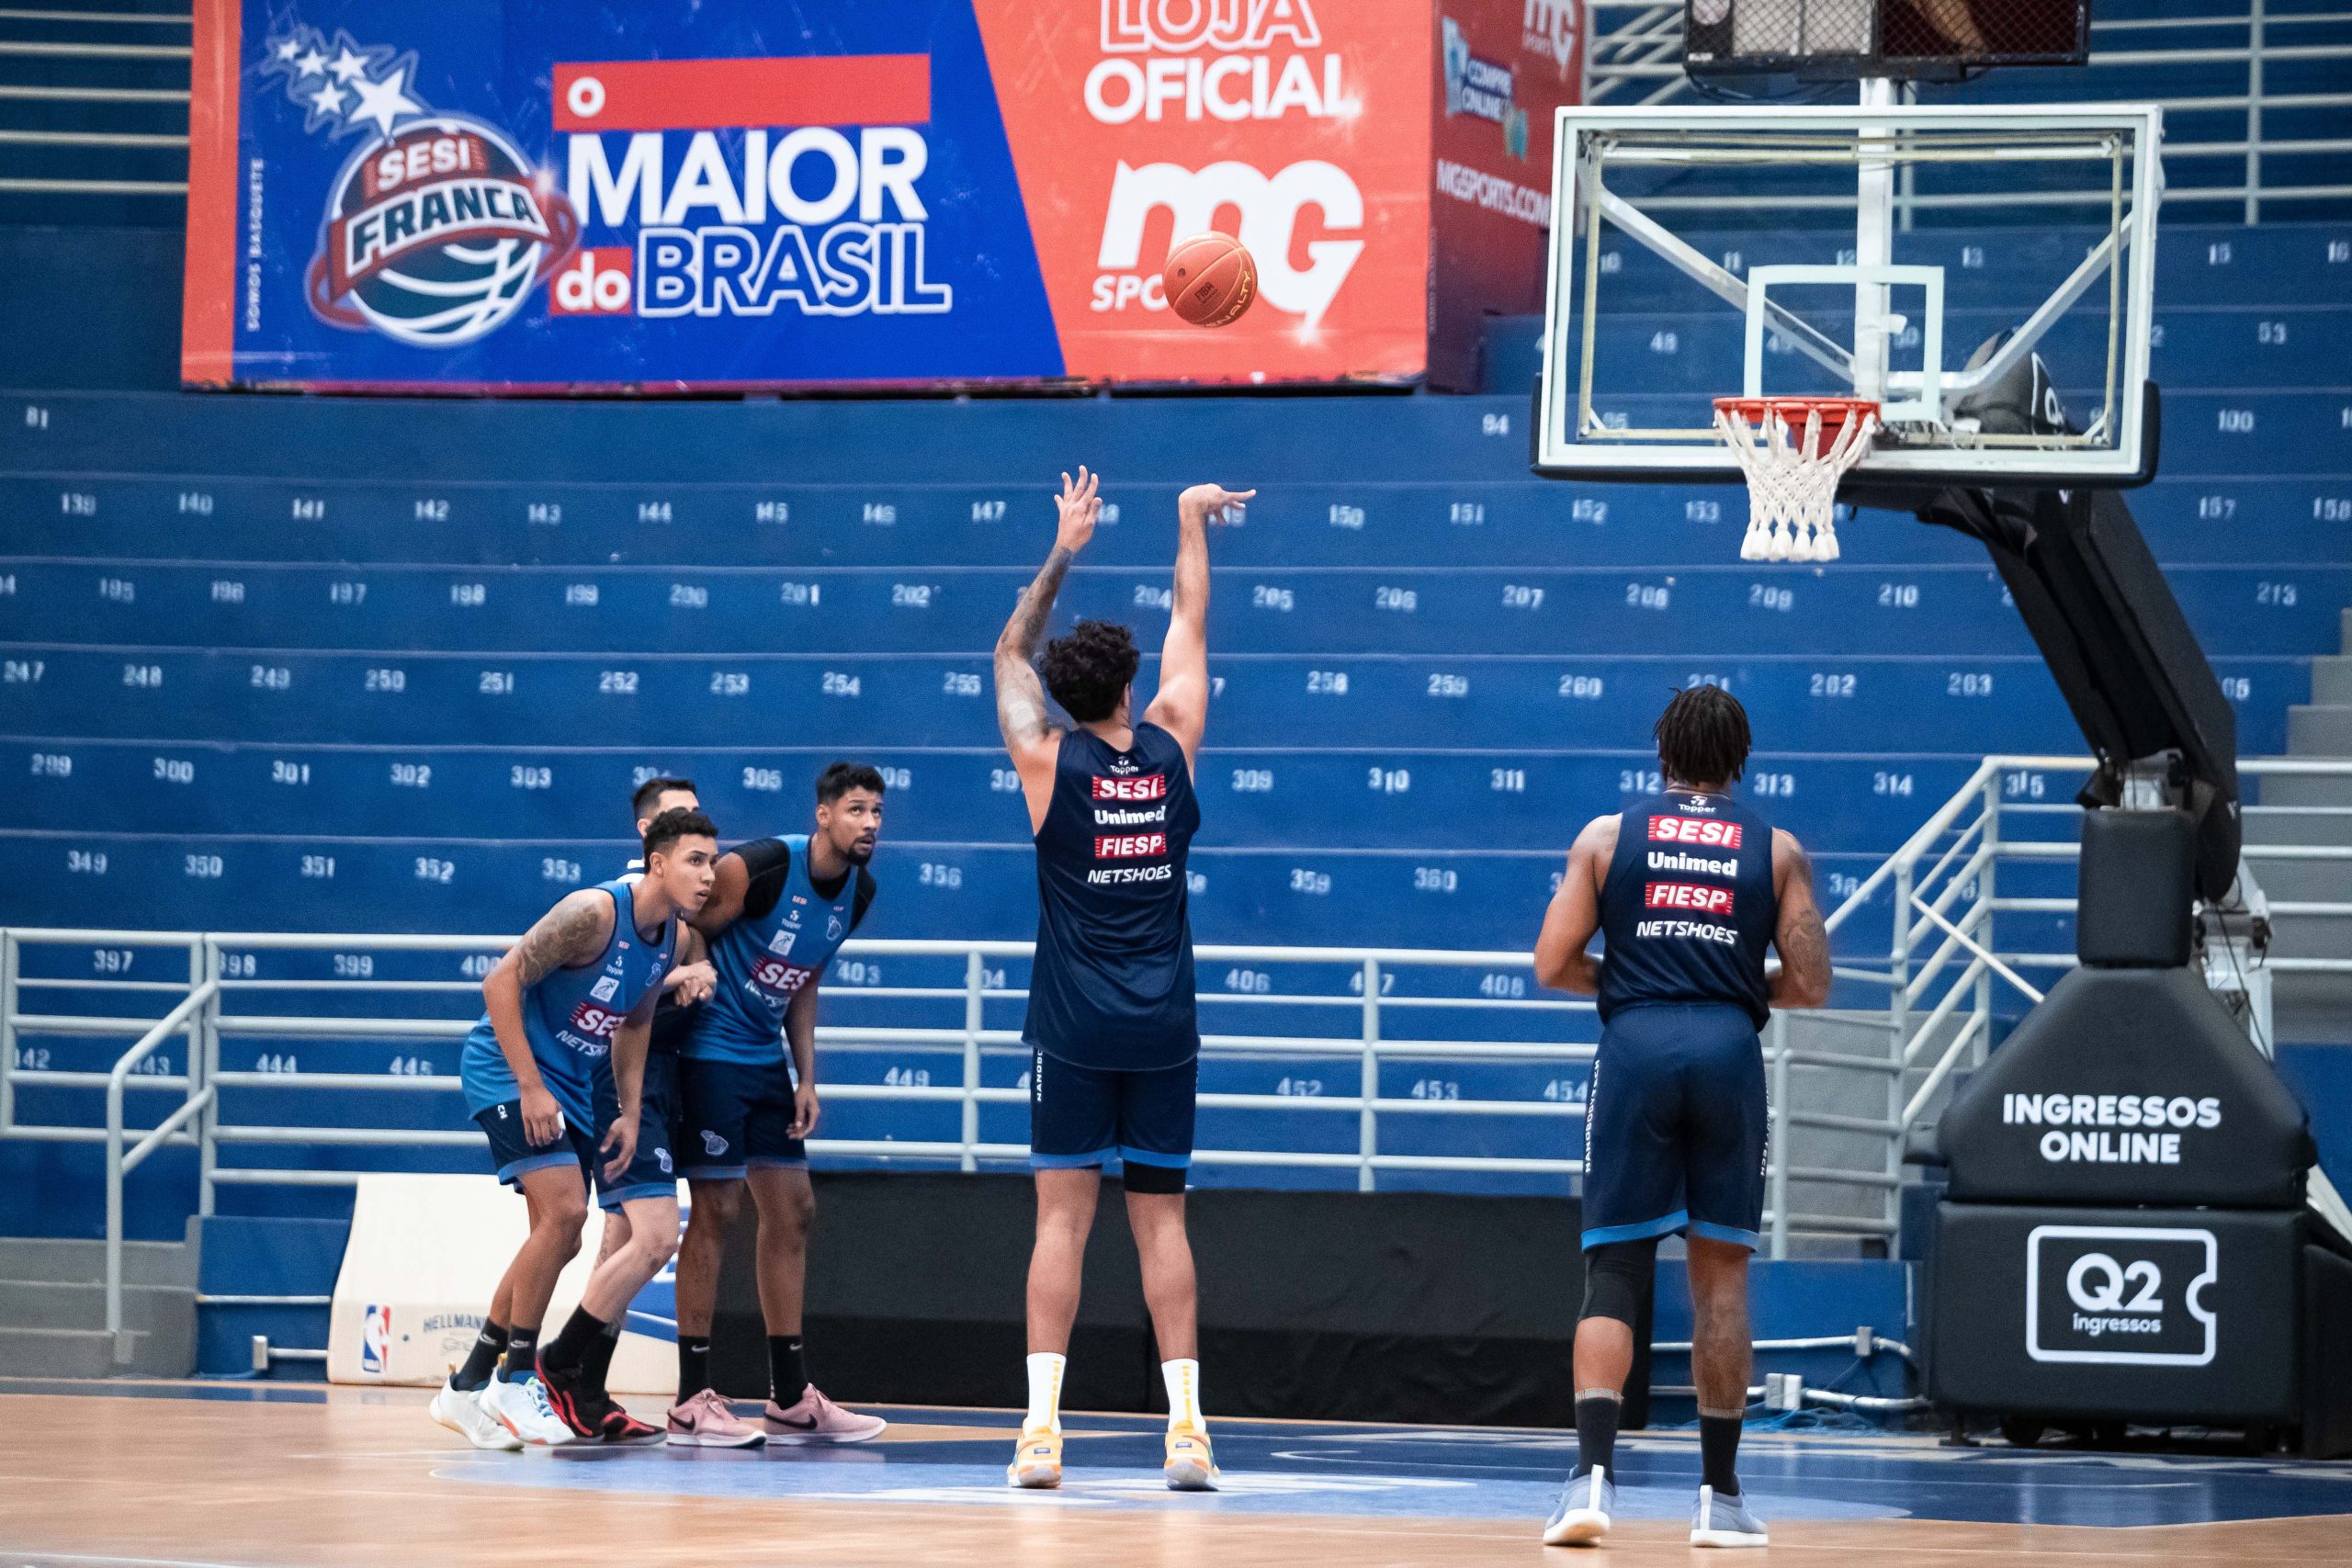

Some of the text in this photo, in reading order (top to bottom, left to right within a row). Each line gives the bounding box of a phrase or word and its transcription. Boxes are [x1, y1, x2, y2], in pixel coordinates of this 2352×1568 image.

[1101, 0, 1323, 52] LOJA
[1084, 53, 1363, 124] OFICIAL
[378, 138, 471, 192] SESI
[568, 126, 929, 228] MAIOR
[347, 181, 544, 274] FRANCA
[556, 221, 954, 318] do BRASIL
[1723, 250, 1743, 274] 11
[1962, 246, 1984, 268] 13
[1091, 274, 1167, 311] SPO
[1650, 331, 1679, 354] 48
[1482, 412, 1510, 436] 94
[2218, 409, 2255, 433] 100
[178, 491, 214, 515] 140
[292, 498, 325, 520] 141
[414, 499, 450, 522] 142
[527, 502, 562, 525] 143
[639, 502, 673, 523] 144
[755, 501, 789, 524] 145
[971, 500, 1007, 523] 147
[1450, 502, 1485, 525] 151
[1571, 498, 1608, 525] 152
[1329, 503, 1365, 530] 150
[329, 581, 368, 604] 197
[450, 582, 486, 606] 198
[781, 581, 820, 606] 201
[892, 583, 931, 608] 202
[1253, 584, 1295, 612] 205
[1375, 586, 1418, 612] 206
[1502, 584, 1545, 610] 207
[1626, 583, 1669, 611] 208
[1749, 583, 1794, 613] 209
[1878, 583, 1919, 608] 210
[3, 660, 45, 682] 247
[123, 663, 163, 687] 248
[250, 664, 291, 690] 249
[365, 668, 406, 693] 250
[479, 671, 514, 695] 251
[598, 671, 639, 694] 252
[709, 671, 751, 696] 253
[1306, 670, 1349, 695] 258
[821, 671, 861, 697] 254
[943, 671, 982, 697] 255
[1427, 672, 1469, 697] 259
[1558, 674, 1604, 699] 260
[153, 757, 195, 784] 300
[272, 760, 311, 785] 301
[390, 762, 432, 788] 302
[510, 764, 552, 789] 303
[742, 766, 783, 792] 305
[1109, 764, 1139, 775] Topper
[1231, 768, 1274, 792] 309
[1368, 766, 1411, 794] 310
[1490, 768, 1526, 793] 311
[1619, 769, 1661, 795] 312
[1099, 777, 1159, 799] SESI
[1753, 772, 1795, 797] 313
[1873, 772, 1914, 796] 314
[2005, 770, 2046, 798] 315
[1094, 805, 1167, 825] Unimed
[1678, 803, 1716, 813] Topper
[1656, 818, 1735, 845] SESI
[1101, 834, 1163, 856] FIESP
[185, 853, 224, 878] 350
[300, 854, 336, 878] 351
[414, 856, 456, 884] 352
[542, 857, 582, 884] 353
[1087, 863, 1172, 884] NETSHOES
[1647, 852, 1738, 877] Unimed
[1290, 867, 1332, 896] 359
[1652, 885, 1727, 909] FIESP
[1636, 920, 1738, 946] NETSHOES
[93, 948, 135, 974] 397
[334, 953, 375, 978] 399
[836, 958, 880, 986] 403
[758, 962, 810, 991] SES
[1224, 967, 1272, 995] 406
[1479, 972, 1526, 998] 408
[2003, 1093, 2222, 1128] INGRESSOS
[2040, 1130, 2181, 1165] ONLINE
[2066, 1252, 2164, 1313] Q2
[2073, 1312, 2162, 1337] ingressos
